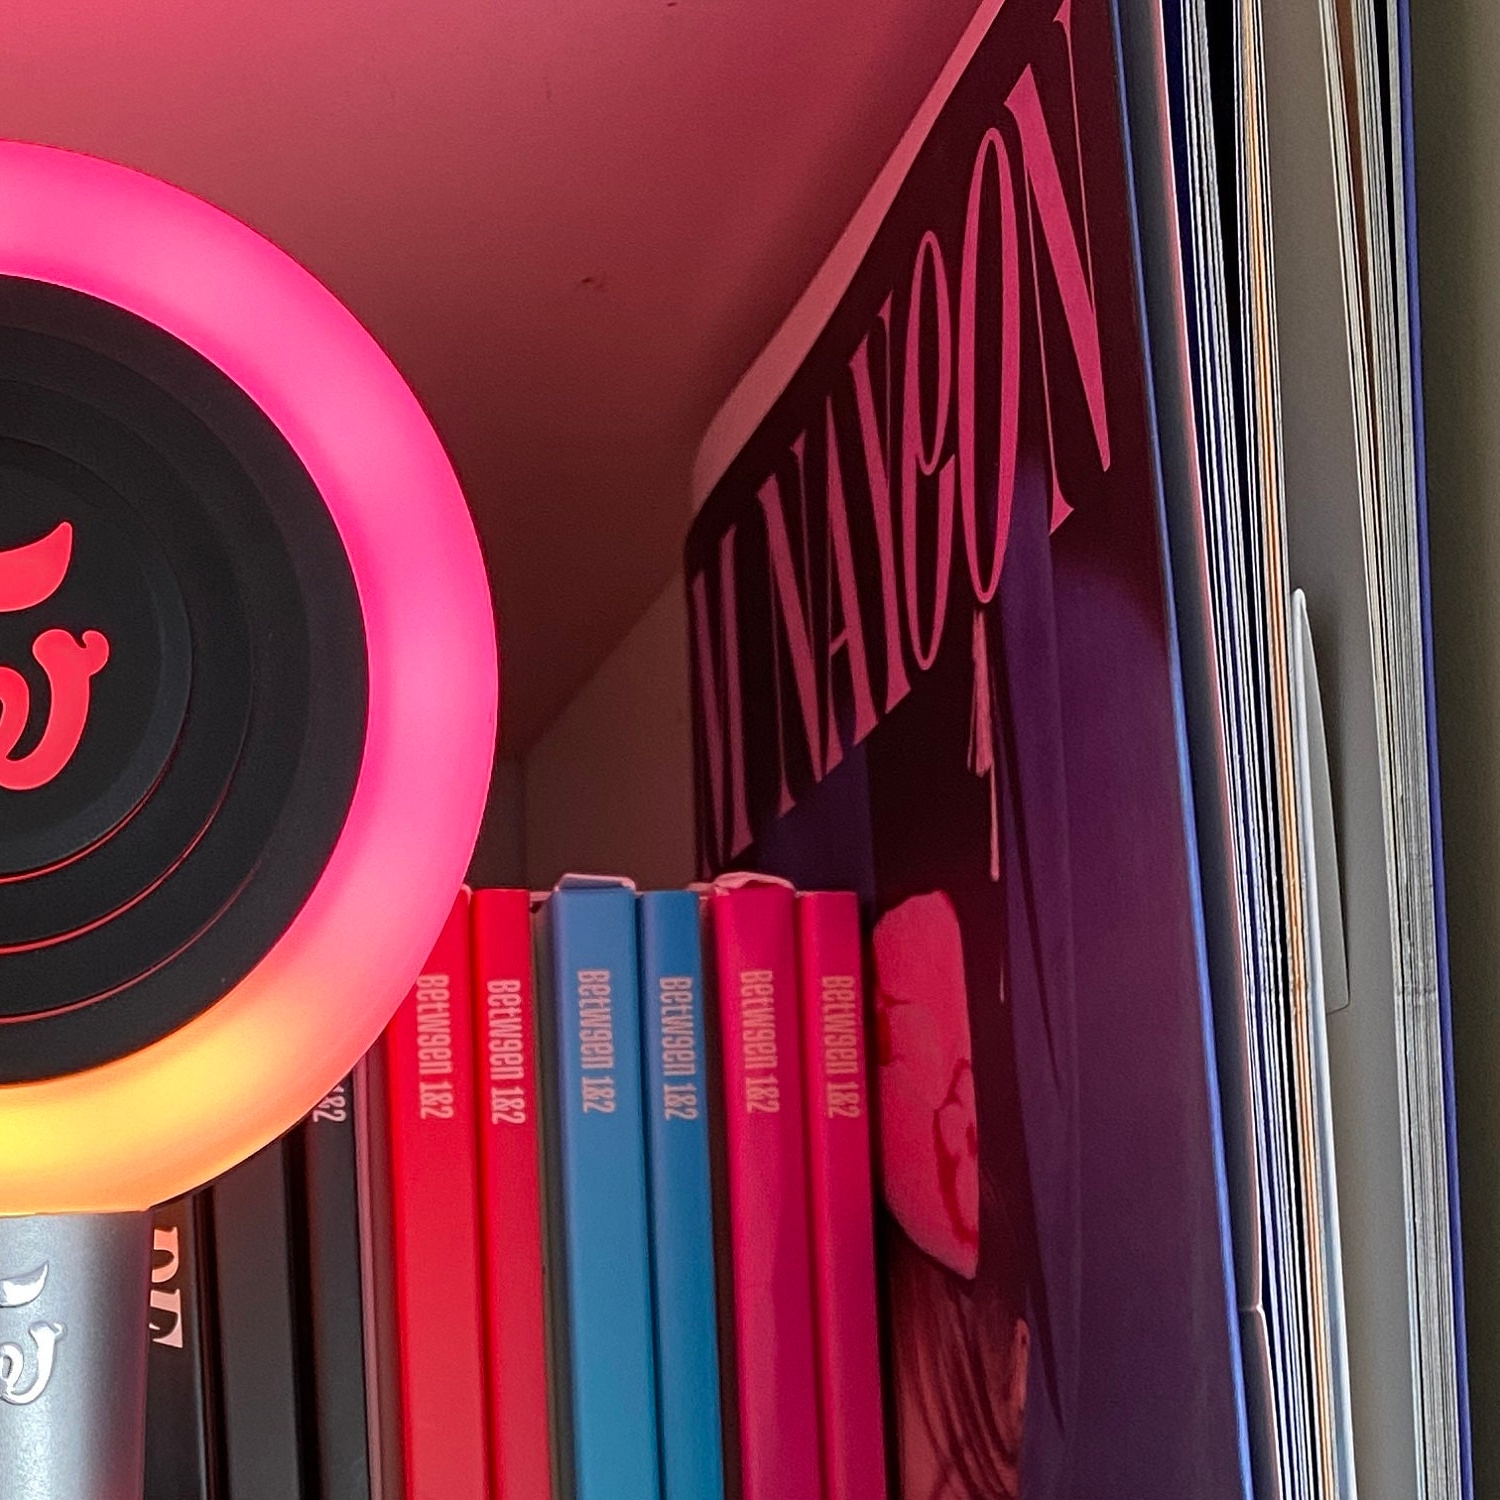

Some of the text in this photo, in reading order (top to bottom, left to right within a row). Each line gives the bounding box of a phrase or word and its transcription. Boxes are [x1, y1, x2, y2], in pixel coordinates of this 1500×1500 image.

[419, 1081, 454, 1120] 1&2
[491, 1086, 526, 1125] 1&2
[581, 1075, 616, 1114] 1&2
[663, 1083, 699, 1120] 1&2
[745, 1074, 780, 1114] 1&2
[827, 1081, 861, 1119] 1&2
